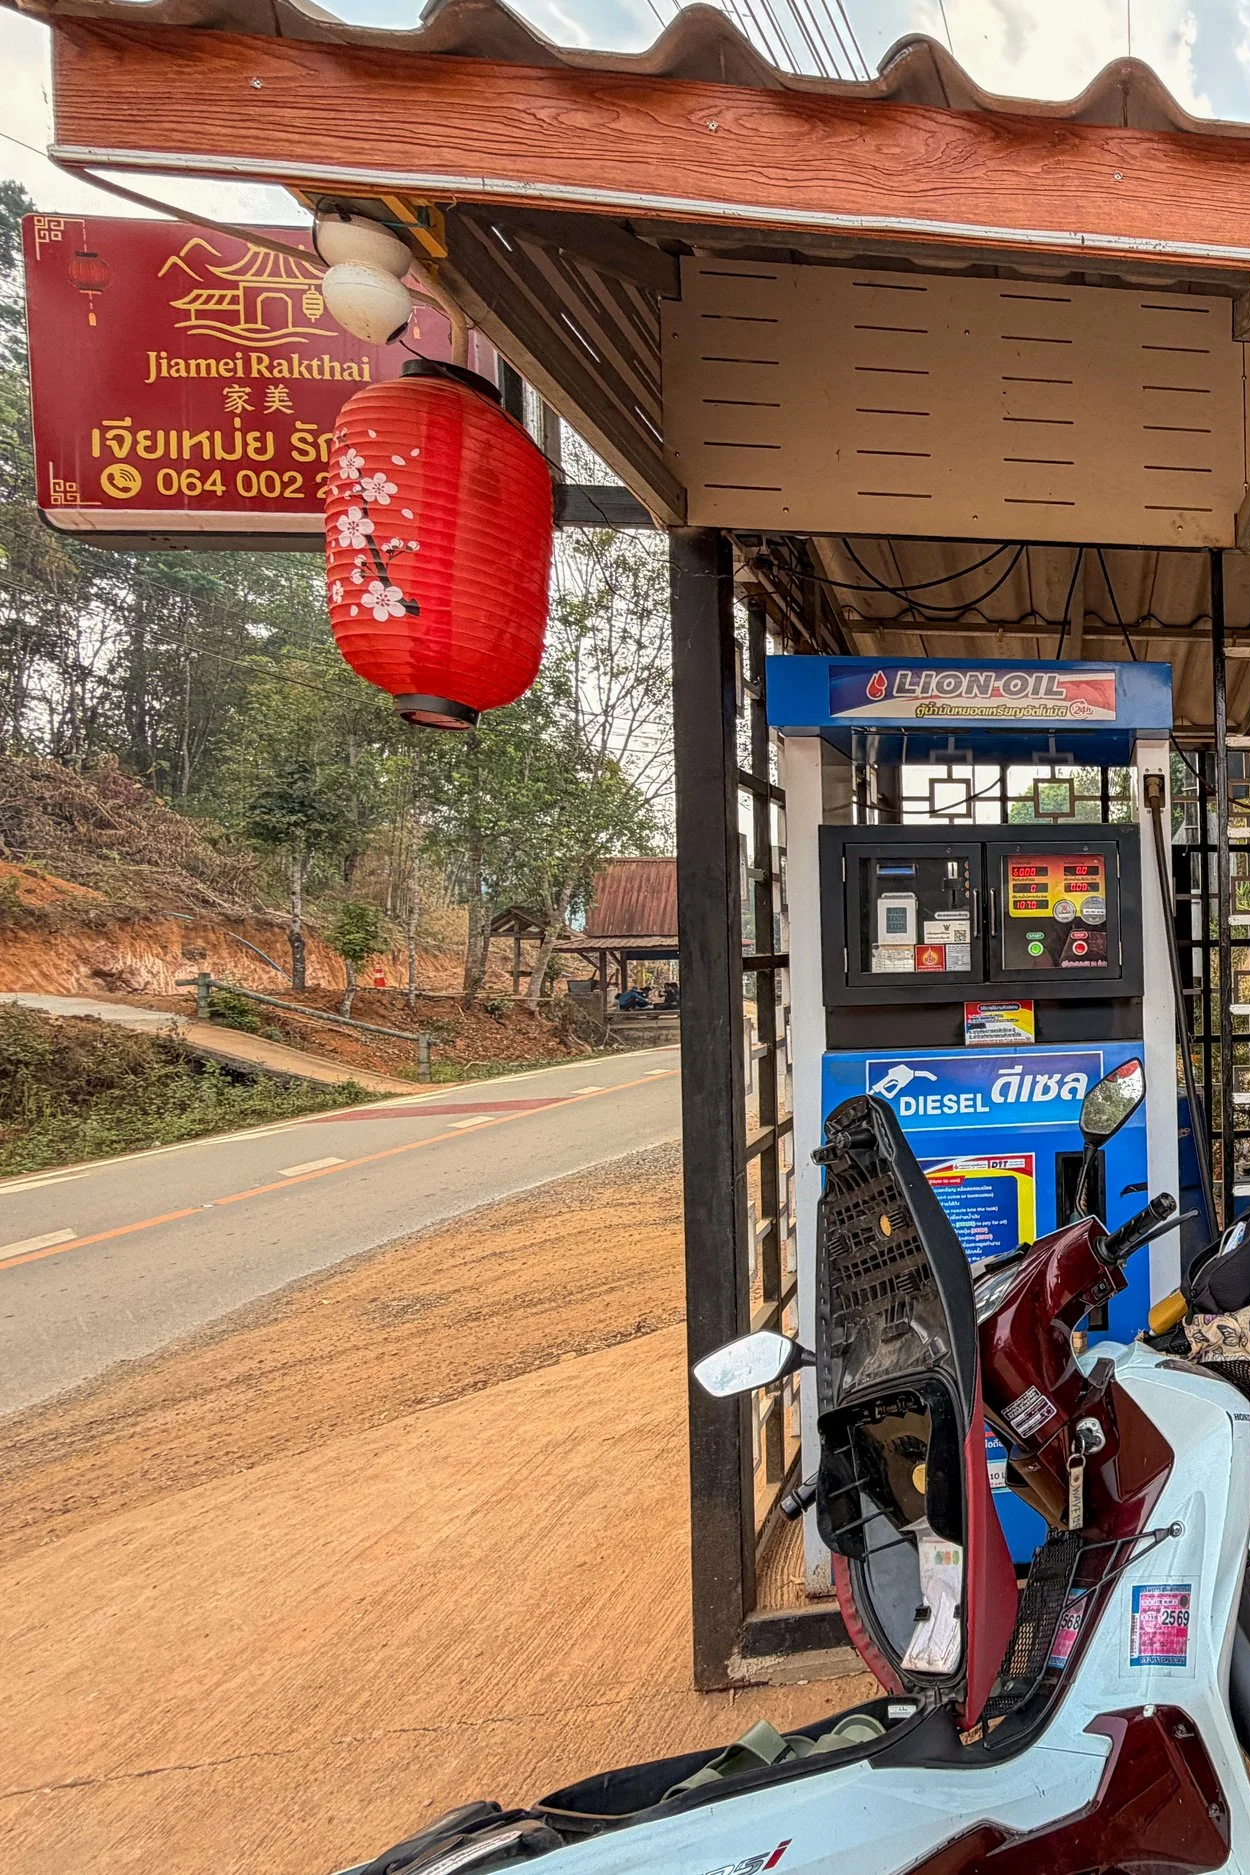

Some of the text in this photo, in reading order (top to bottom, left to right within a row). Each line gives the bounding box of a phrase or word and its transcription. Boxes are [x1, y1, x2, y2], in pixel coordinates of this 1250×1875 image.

[144, 351, 372, 384] Jiamei Rakthai
[91, 416, 275, 462] เจียเหม่ย
[157, 468, 226, 497] 064
[236, 469, 305, 499] 002
[893, 671, 1067, 699] LION OIL
[991, 1065, 1089, 1104] ดีเซล
[900, 1093, 990, 1117] DIESEL
[990, 1472, 1000, 1480] 10
[1060, 1614, 1081, 1630] 568
[1162, 1610, 1190, 1627] 2569
